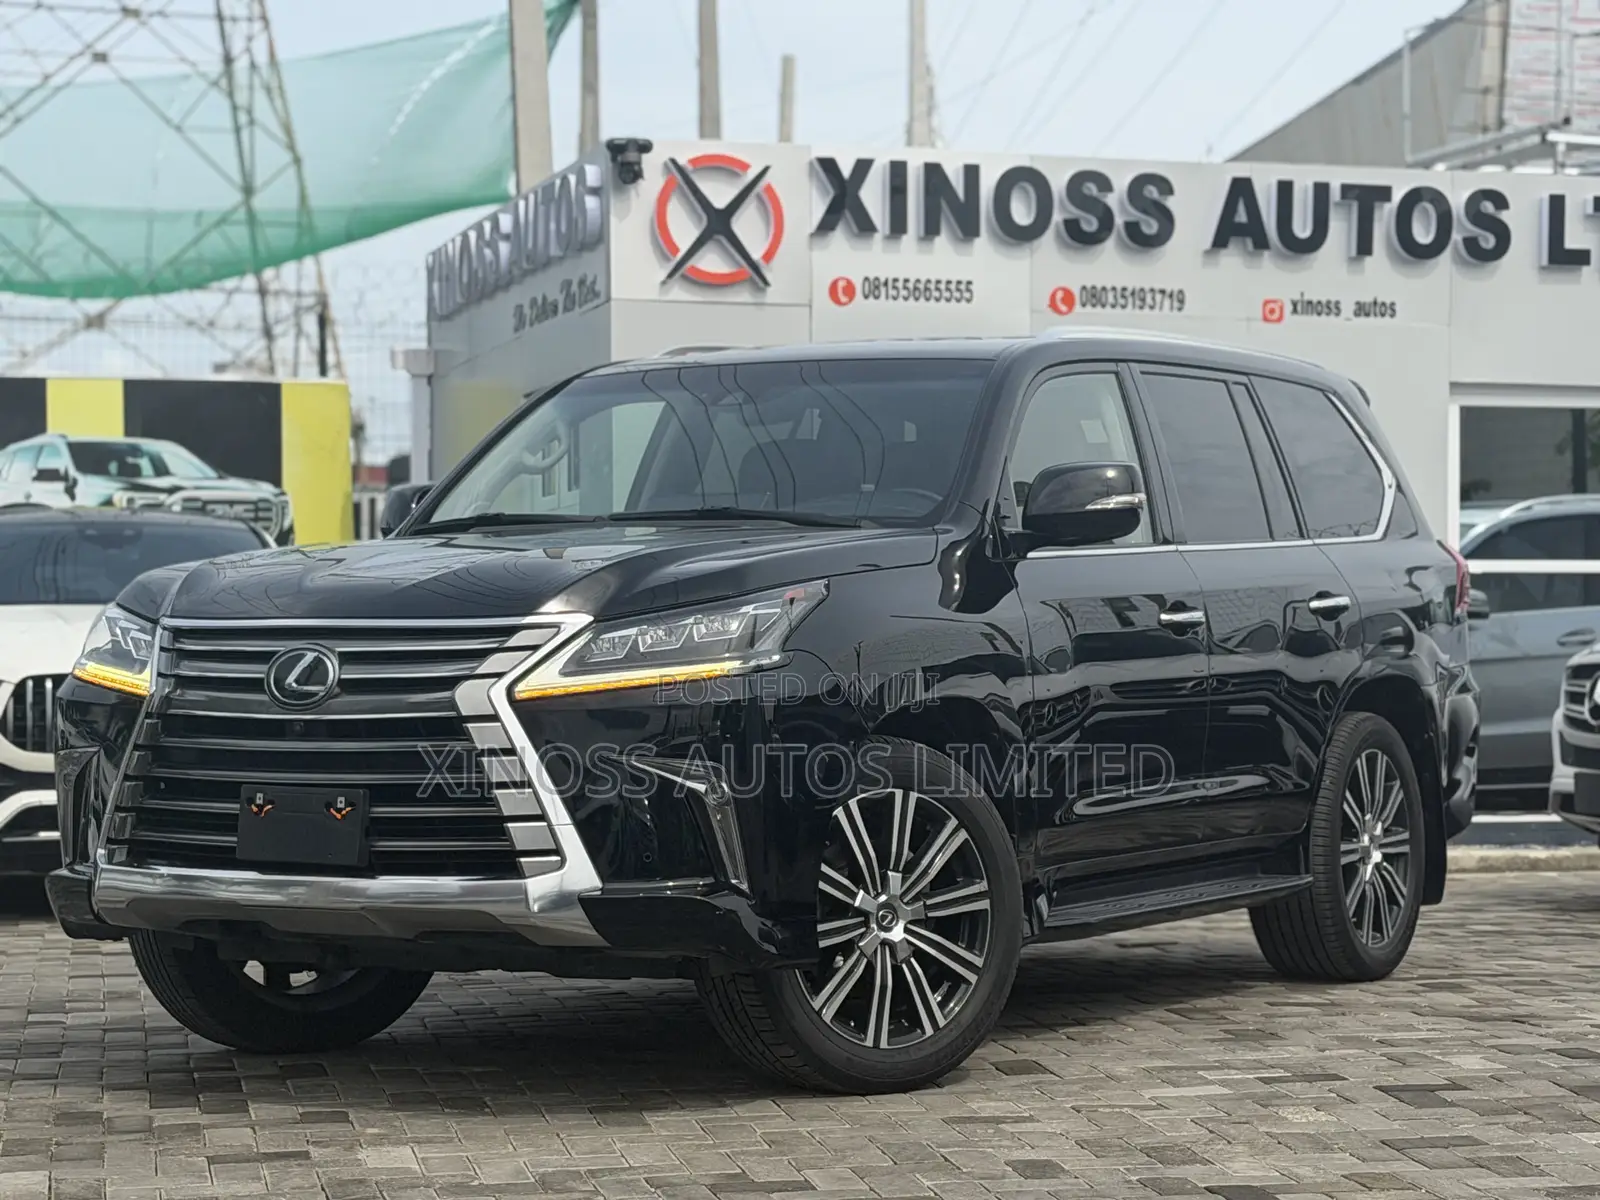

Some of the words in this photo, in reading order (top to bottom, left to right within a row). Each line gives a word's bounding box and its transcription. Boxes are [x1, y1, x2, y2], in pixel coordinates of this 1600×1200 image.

[811, 156, 1175, 249] XINOSS
[1205, 176, 1512, 262] AUTOS
[1542, 193, 1600, 267] L
[861, 276, 974, 304] 08155665555
[1079, 286, 1186, 312] 08035193719
